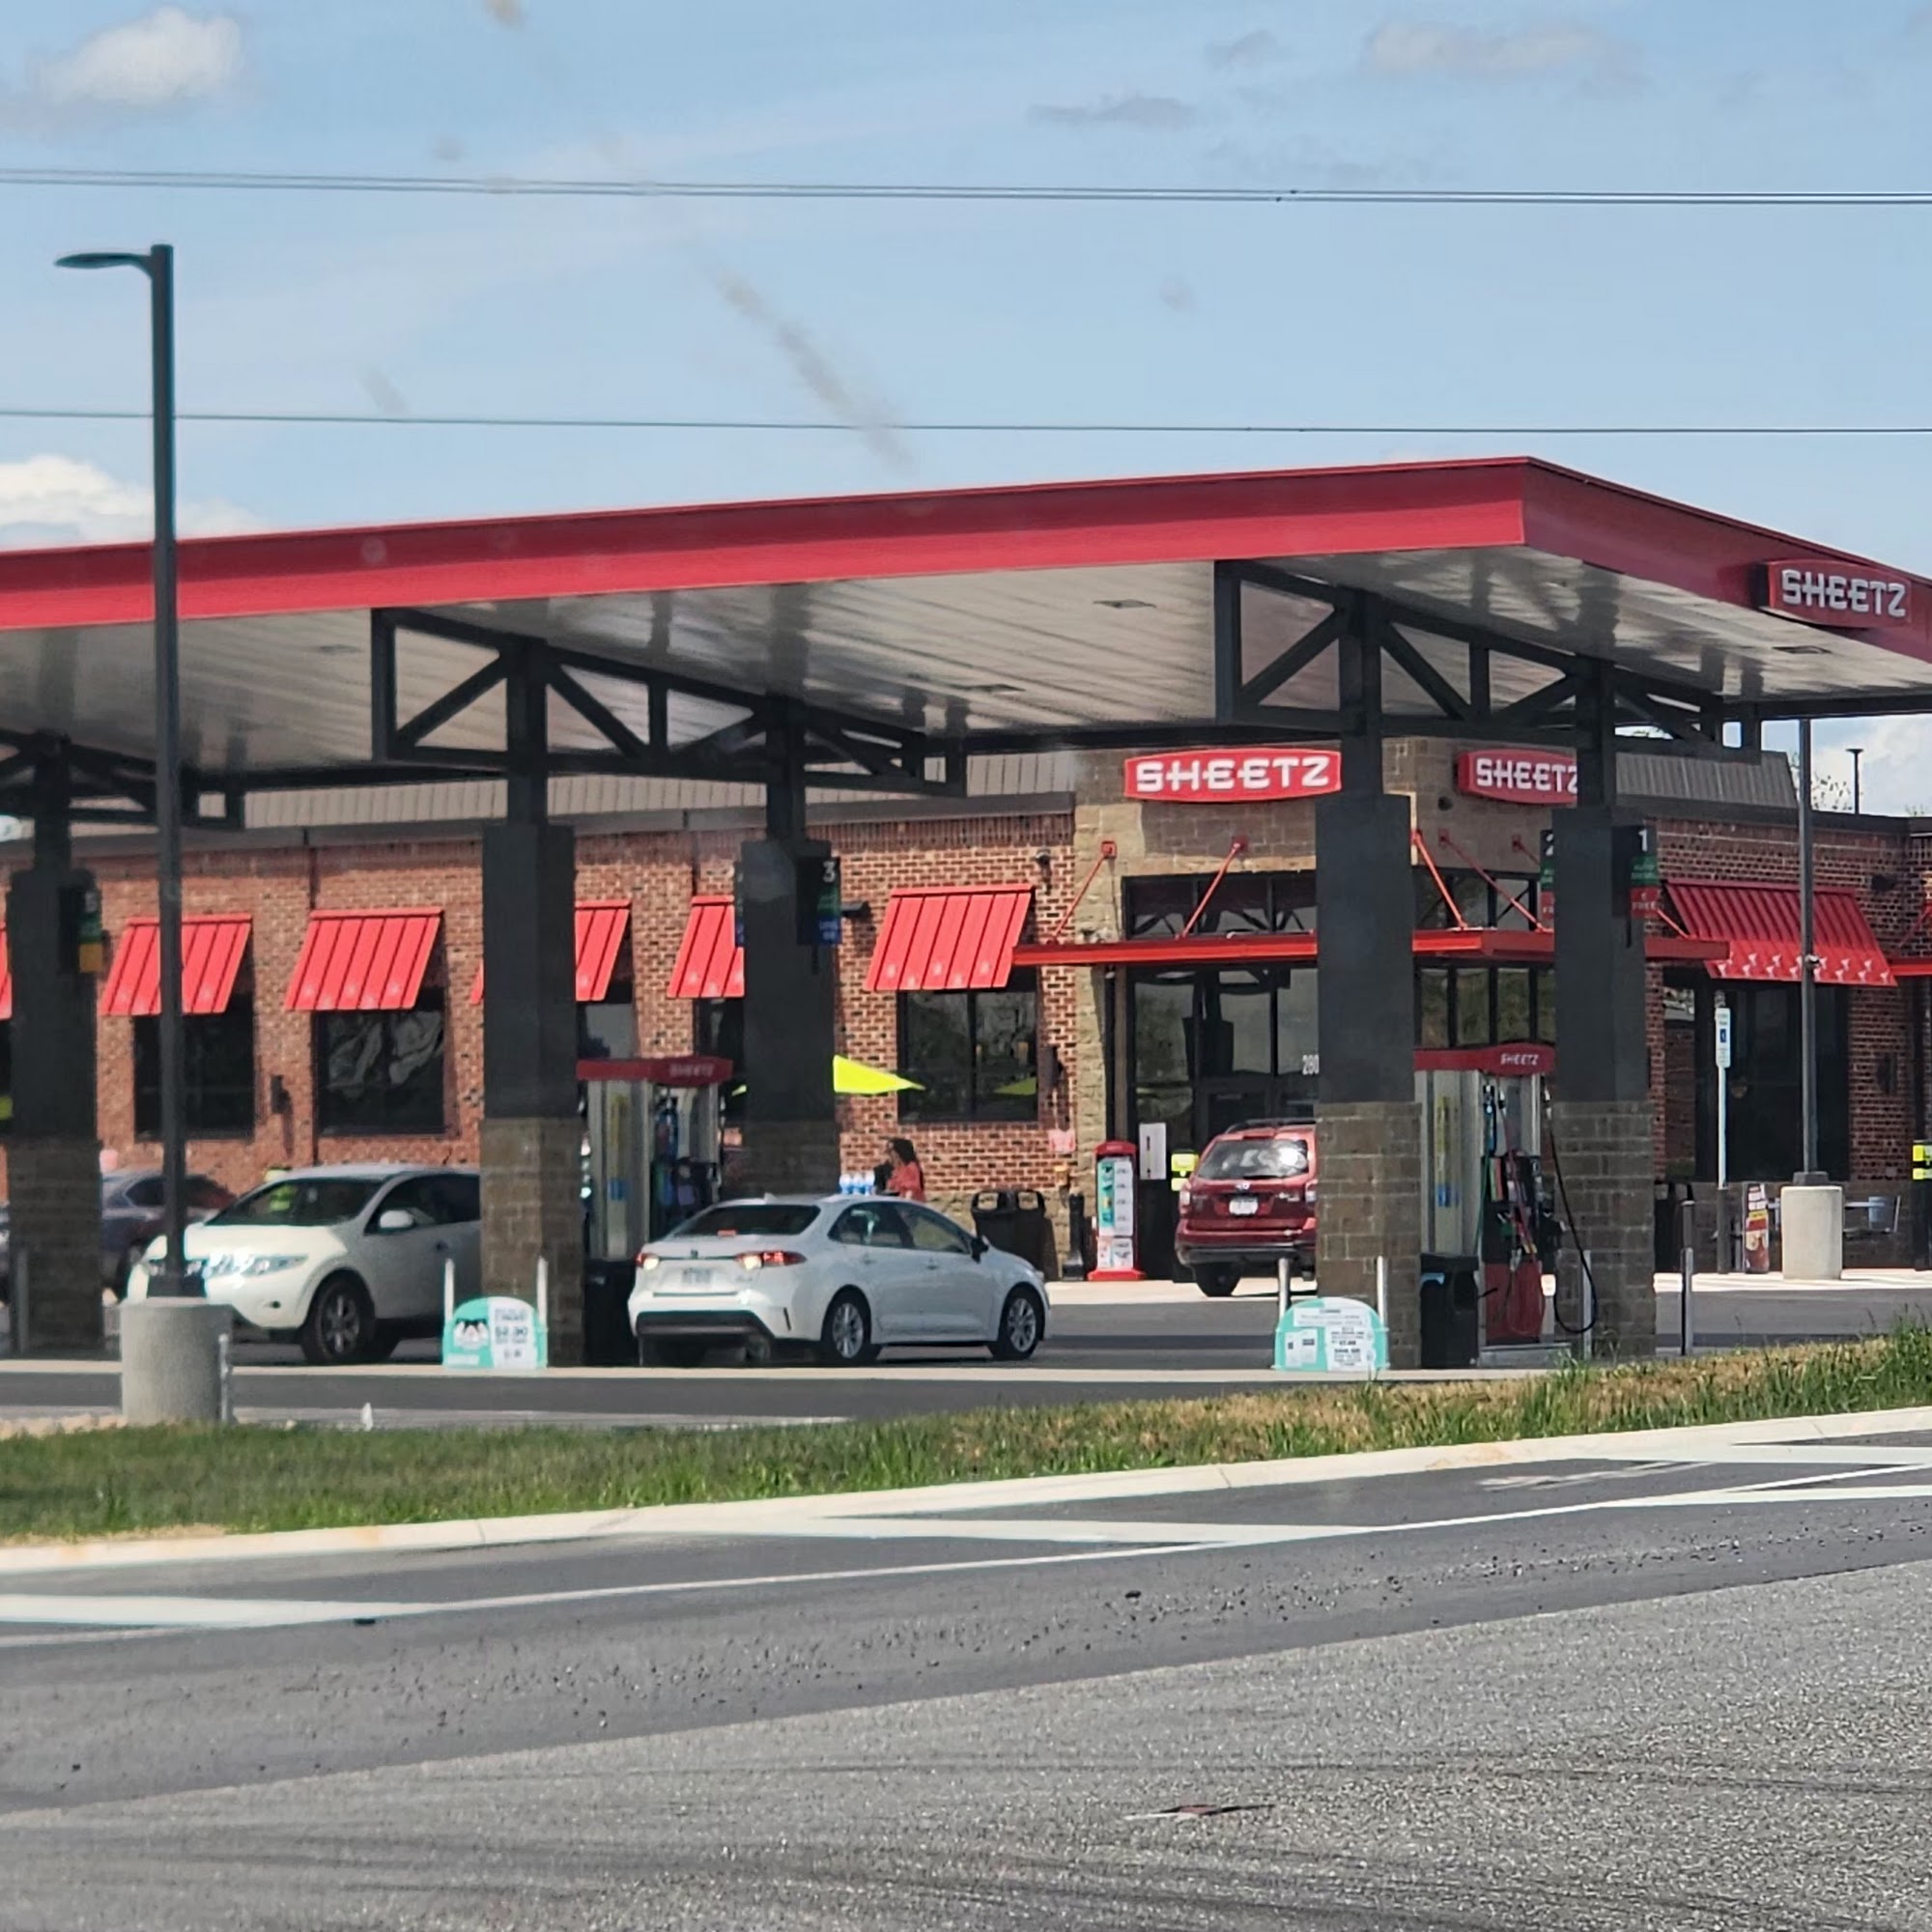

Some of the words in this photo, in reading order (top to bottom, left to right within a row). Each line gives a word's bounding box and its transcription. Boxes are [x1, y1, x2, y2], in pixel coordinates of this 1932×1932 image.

[1781, 569, 1906, 617] SHEETZ
[1136, 756, 1330, 792] SHEETZ
[1638, 829, 1648, 852] 1
[822, 861, 837, 883] 3
